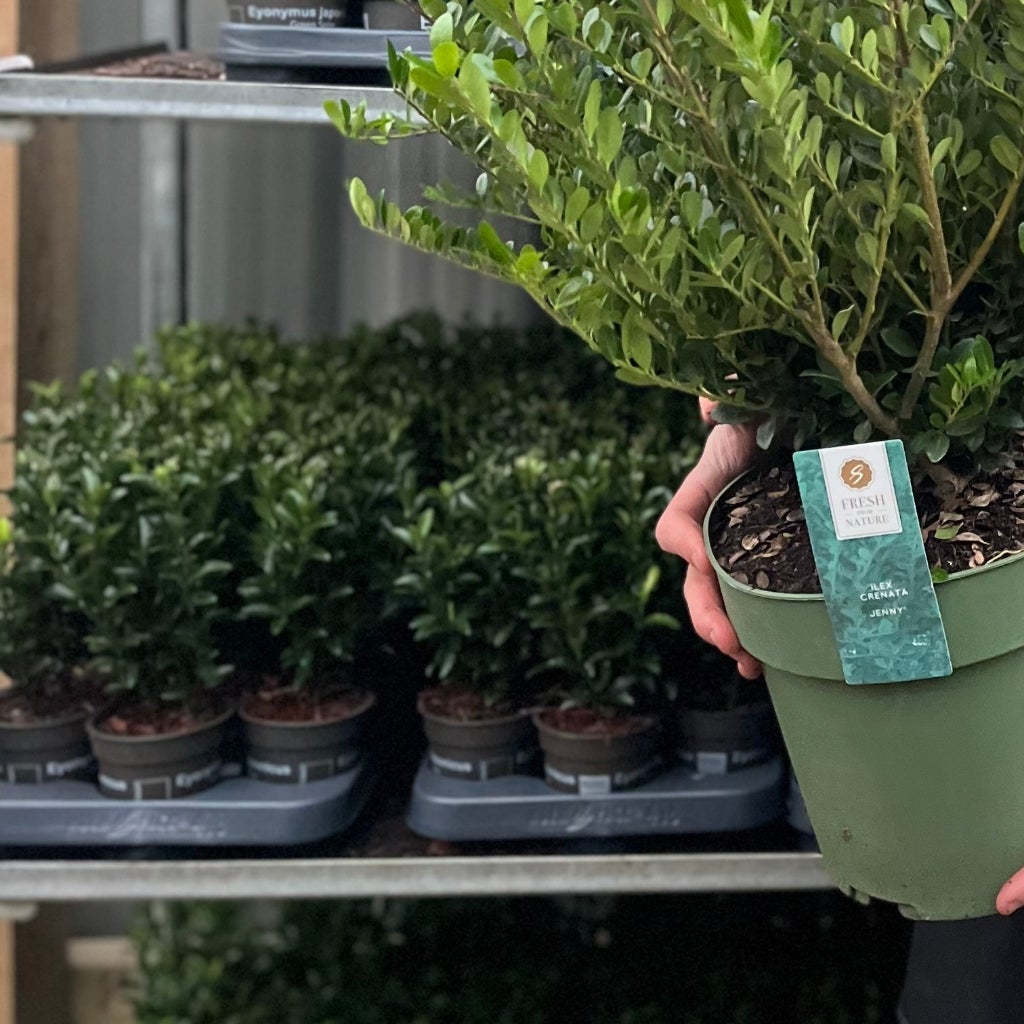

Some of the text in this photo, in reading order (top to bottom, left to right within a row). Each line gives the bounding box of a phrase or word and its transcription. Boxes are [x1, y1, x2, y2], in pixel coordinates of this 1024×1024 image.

[841, 494, 886, 510] FRESH
[846, 514, 889, 527] NATURE
[870, 580, 893, 591] ILEX
[860, 588, 909, 602] CRENATA
